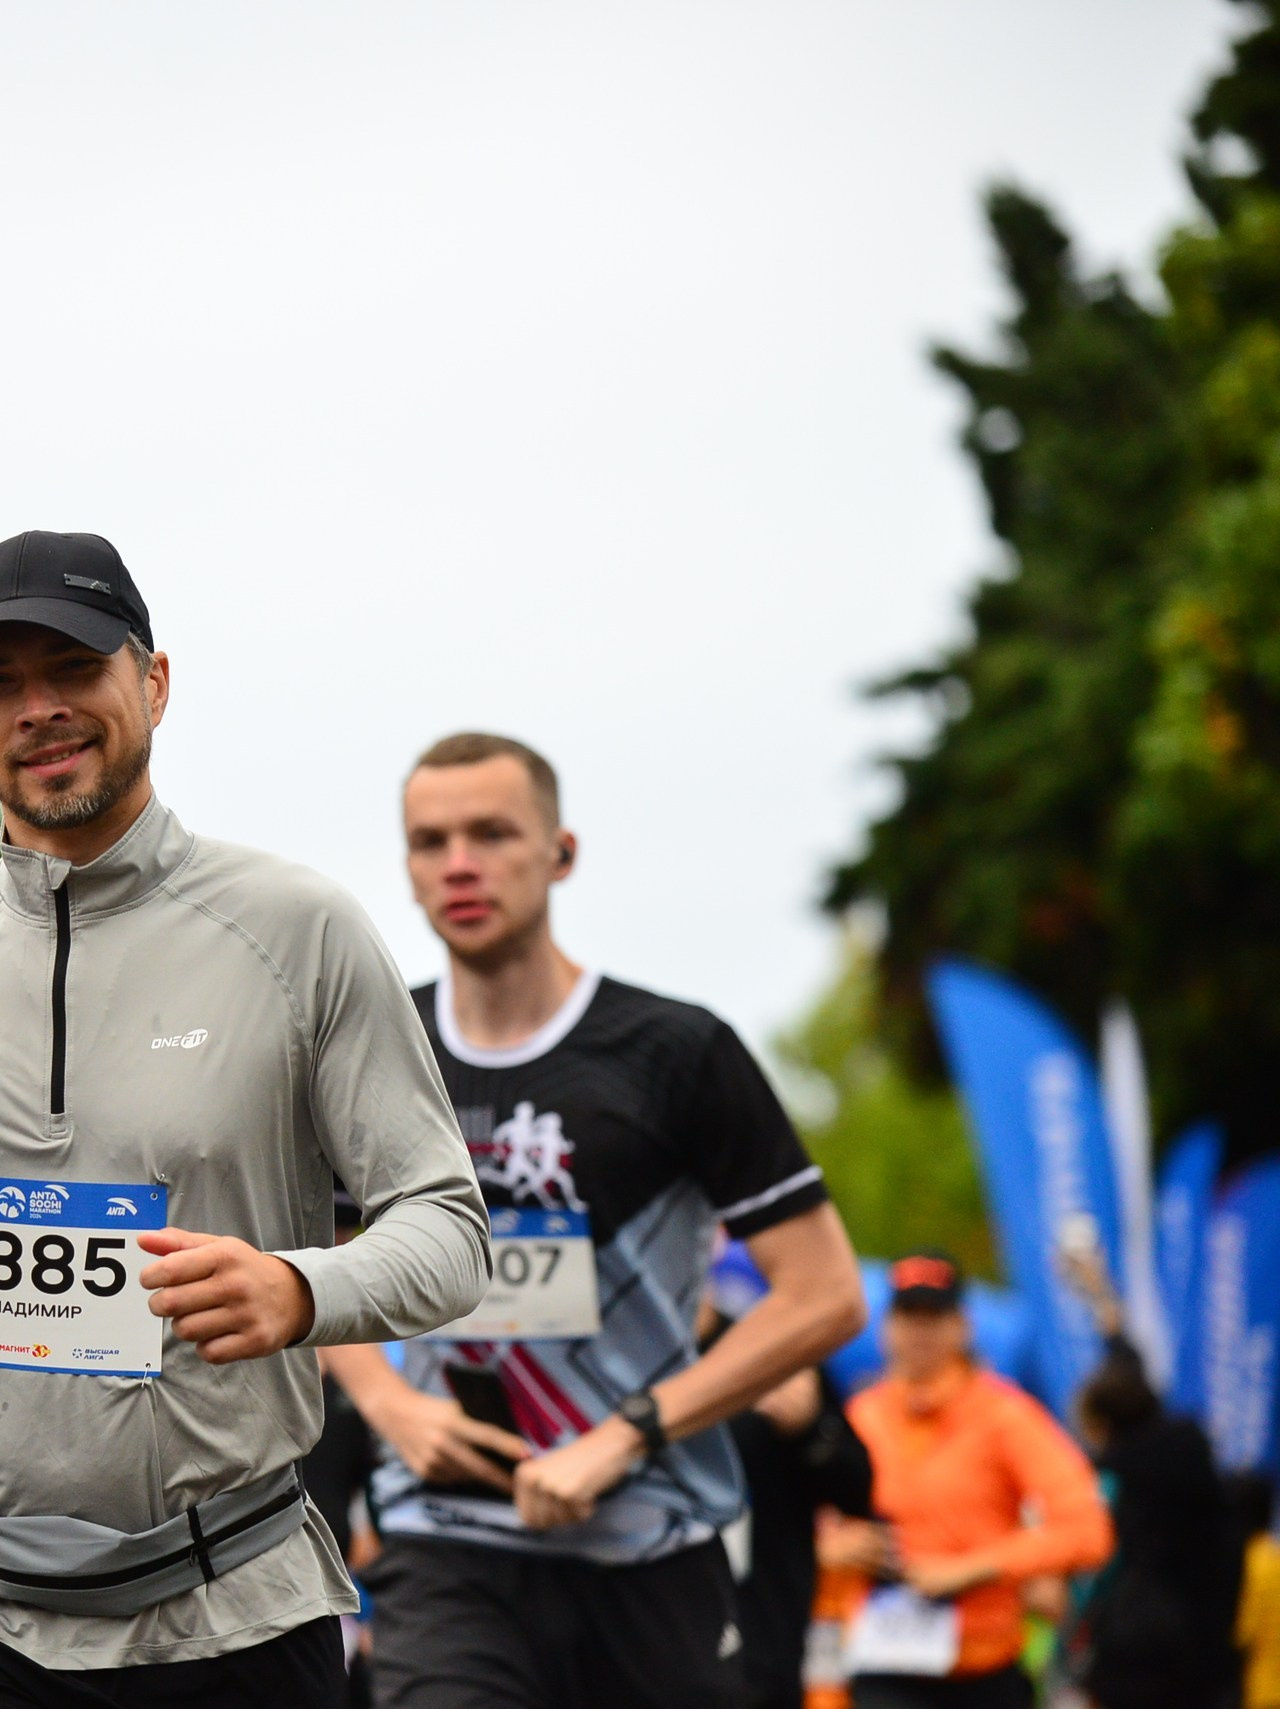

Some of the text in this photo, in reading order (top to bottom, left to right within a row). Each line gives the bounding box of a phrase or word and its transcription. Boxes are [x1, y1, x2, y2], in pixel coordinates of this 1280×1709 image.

[29, 1190, 57, 1200] ANTA
[29, 1199, 62, 1209] SOCHI
[29, 1207, 62, 1215] MARATHON
[106, 1207, 126, 1216] ANTA
[499, 1245, 562, 1287] 07
[0, 1344, 31, 1353] МАГНИТ
